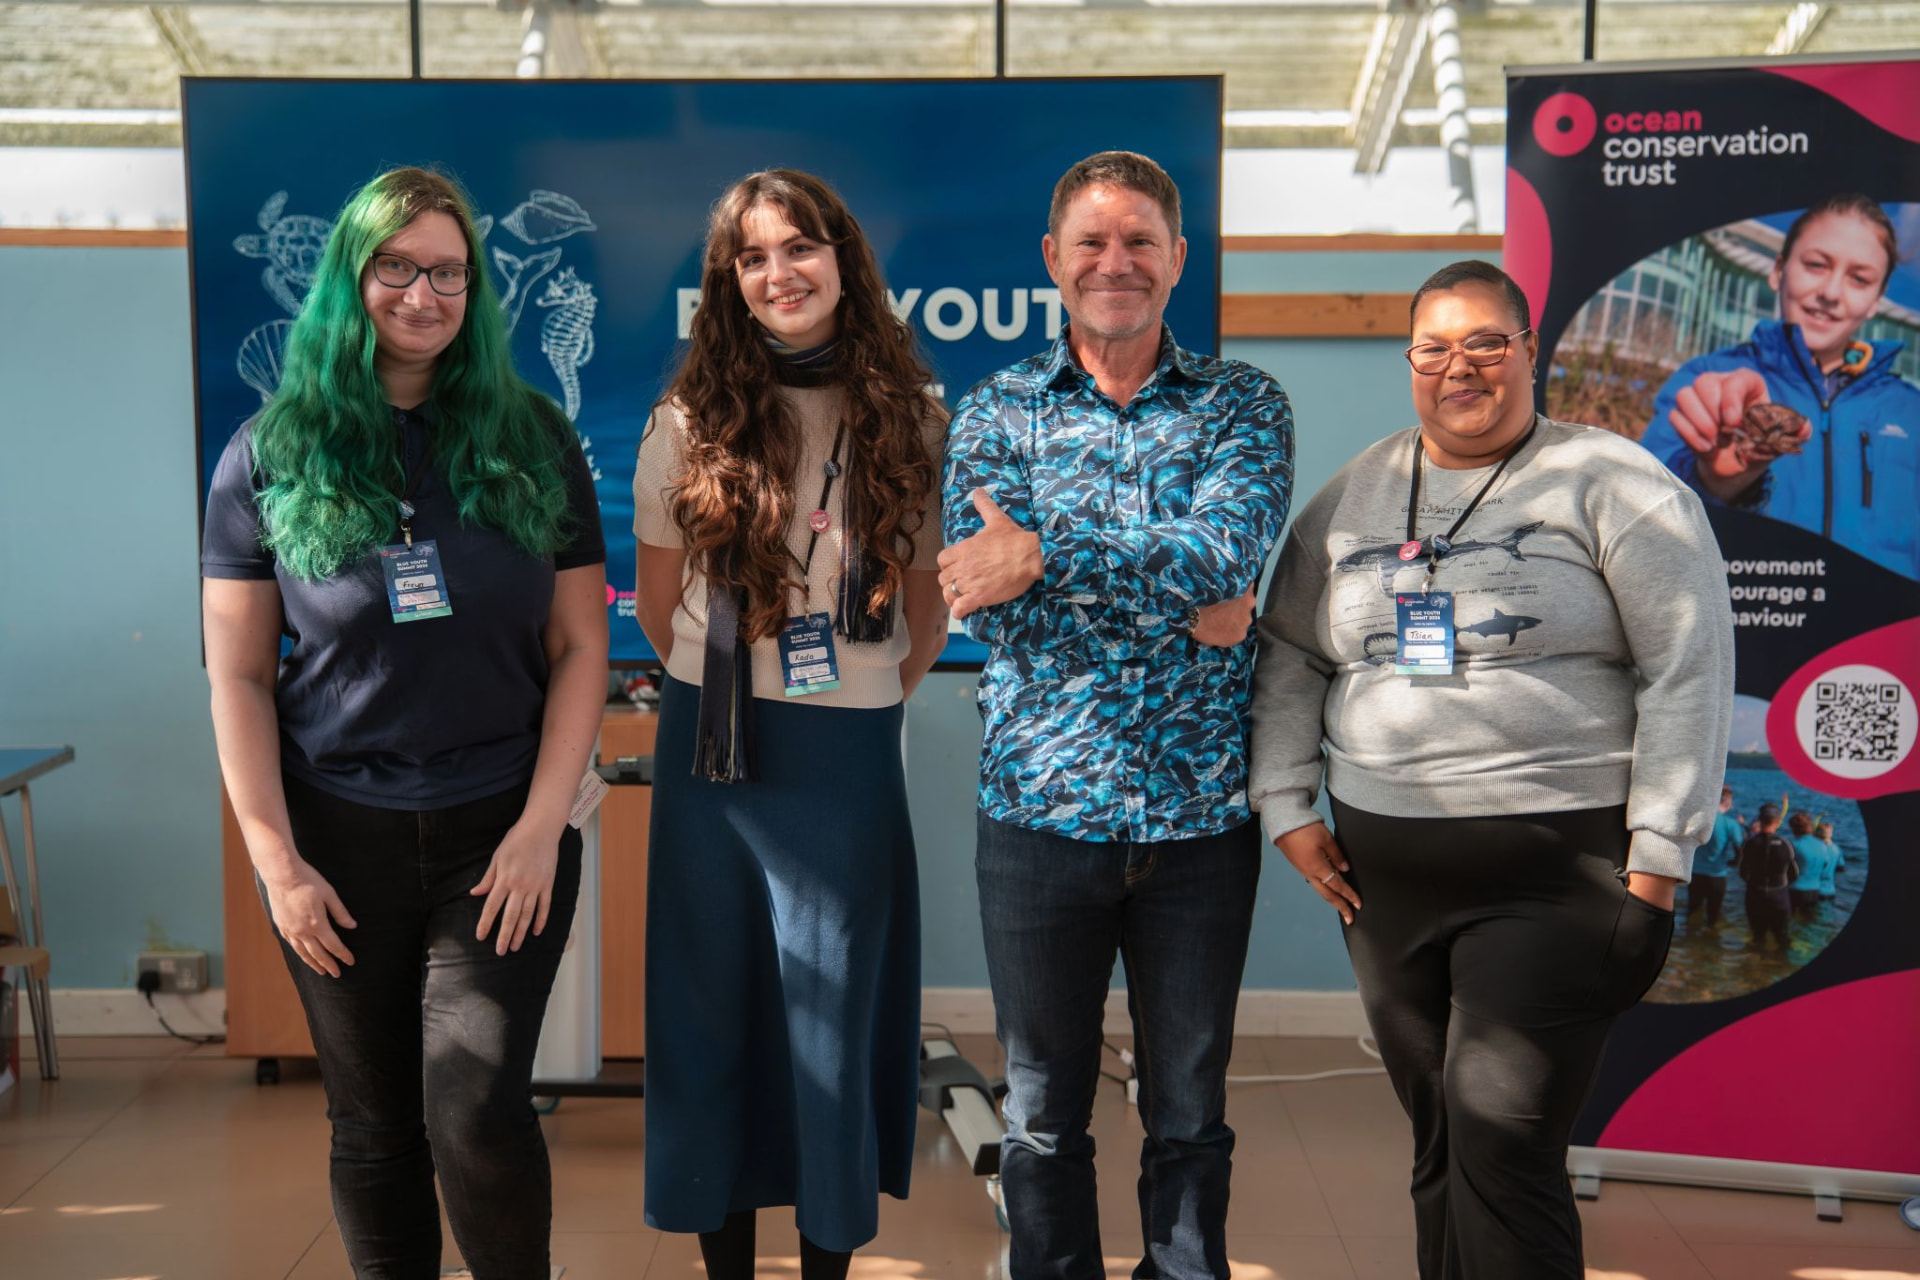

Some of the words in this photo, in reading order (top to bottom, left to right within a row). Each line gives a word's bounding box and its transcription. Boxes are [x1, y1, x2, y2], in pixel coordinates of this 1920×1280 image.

[1604, 111, 1702, 133] ocean
[1603, 125, 1808, 158] conservation
[1602, 160, 1676, 186] trust
[884, 287, 1063, 341] YOUT
[1730, 586, 1808, 605] ourage
[1812, 587, 1826, 602] a
